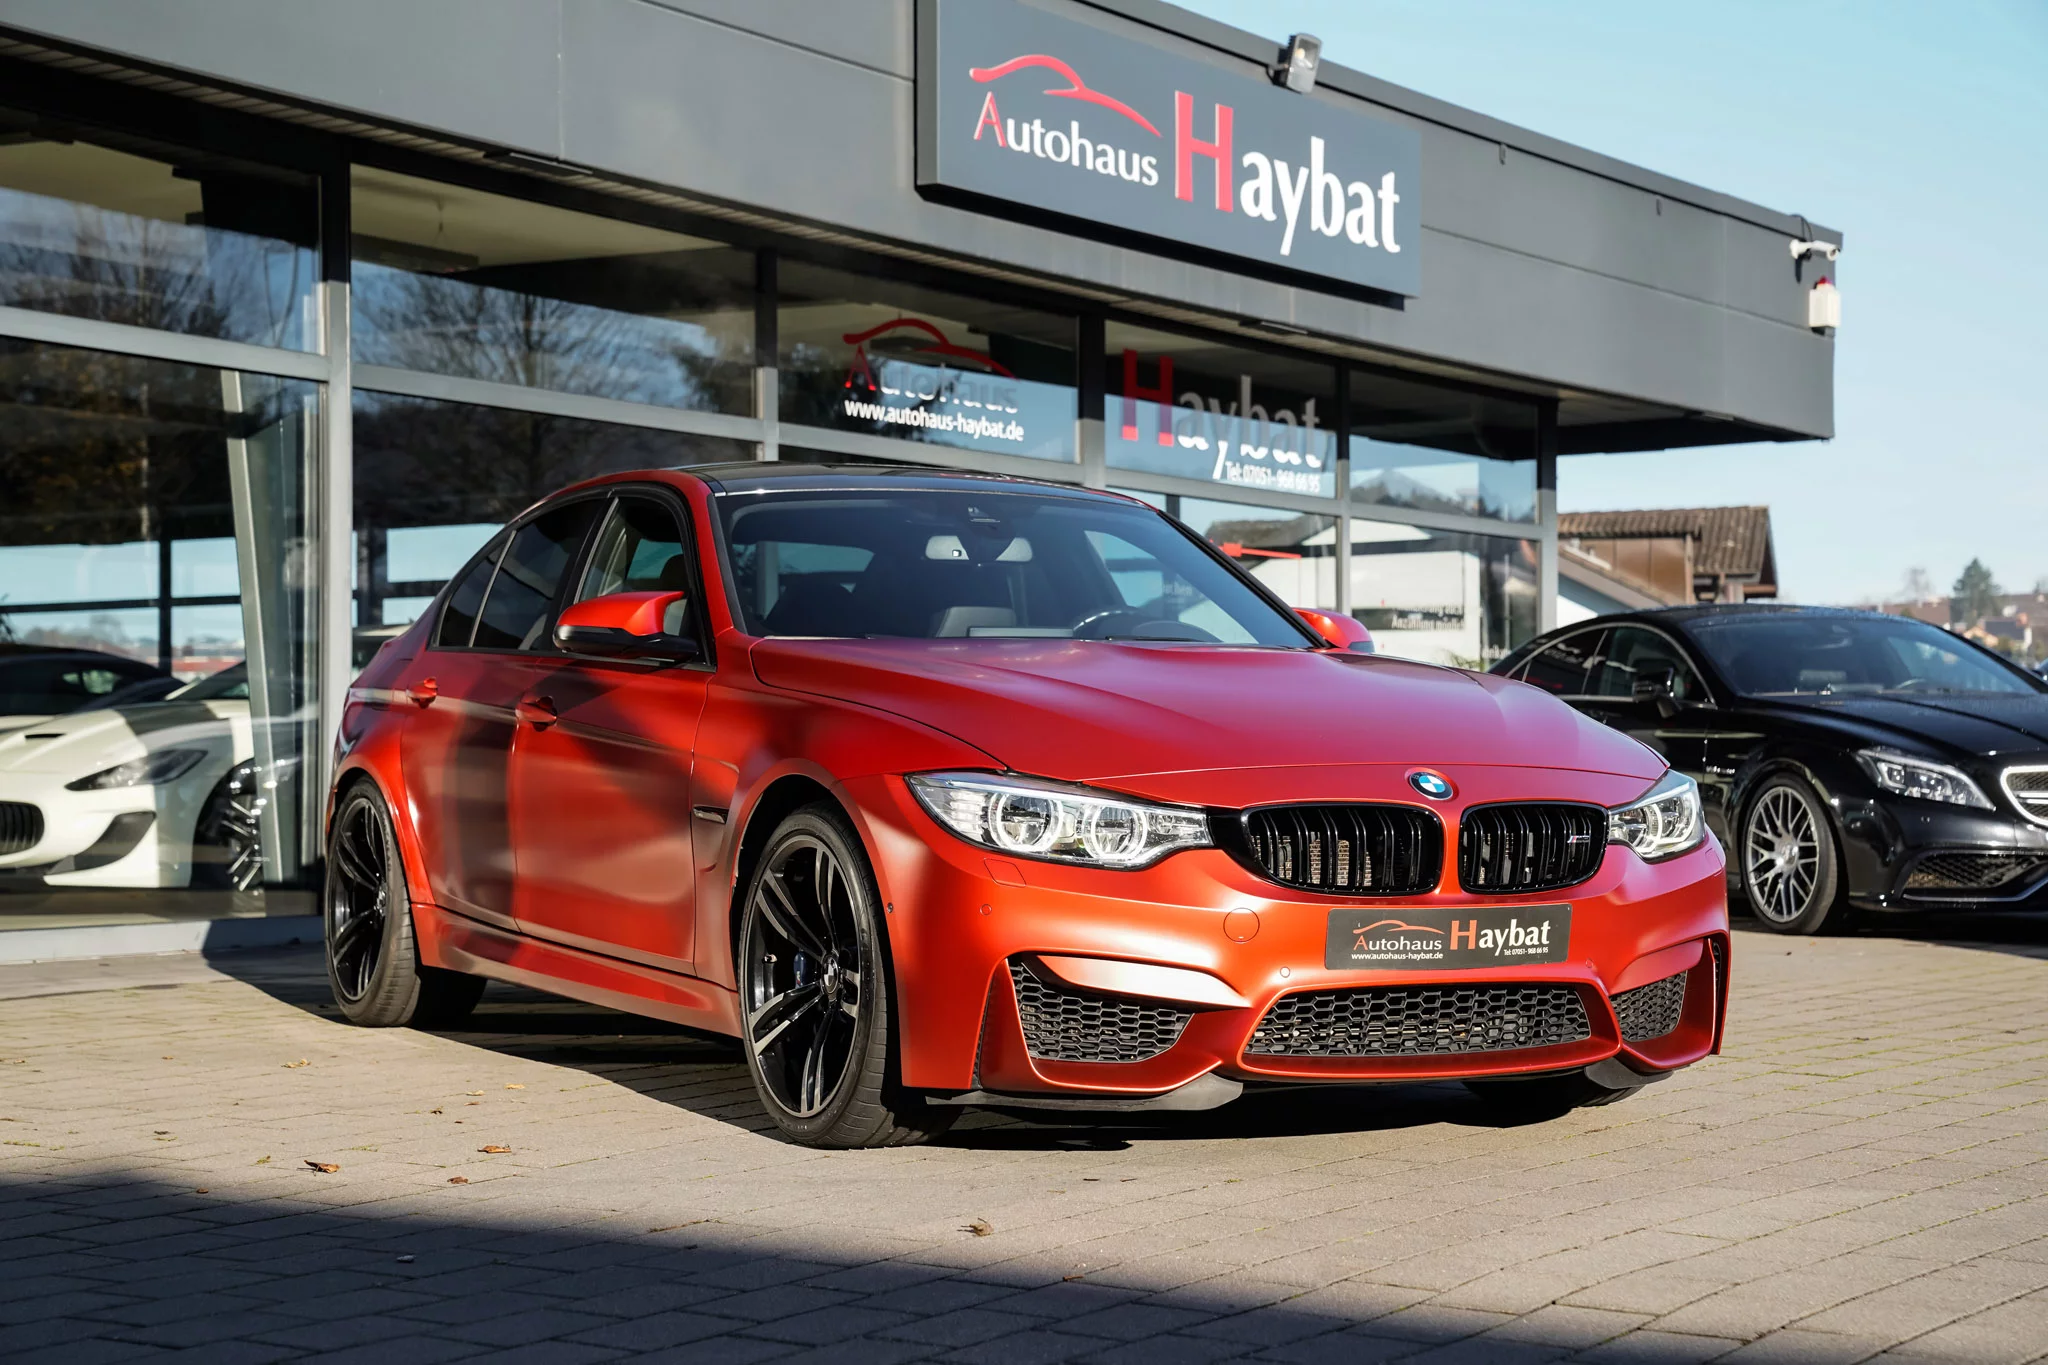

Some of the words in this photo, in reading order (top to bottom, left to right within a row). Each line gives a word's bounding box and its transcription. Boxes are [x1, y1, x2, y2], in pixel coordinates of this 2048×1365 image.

[973, 91, 1160, 187] Autohaus
[1175, 90, 1401, 257] Haybat
[844, 399, 1025, 442] www.autohaus-haybat.de
[1122, 348, 1322, 480] Haybat
[1351, 952, 1444, 961] www.autohaus-haybat.de
[1353, 935, 1443, 951] Autohaus
[1449, 918, 1552, 957] Haybat
